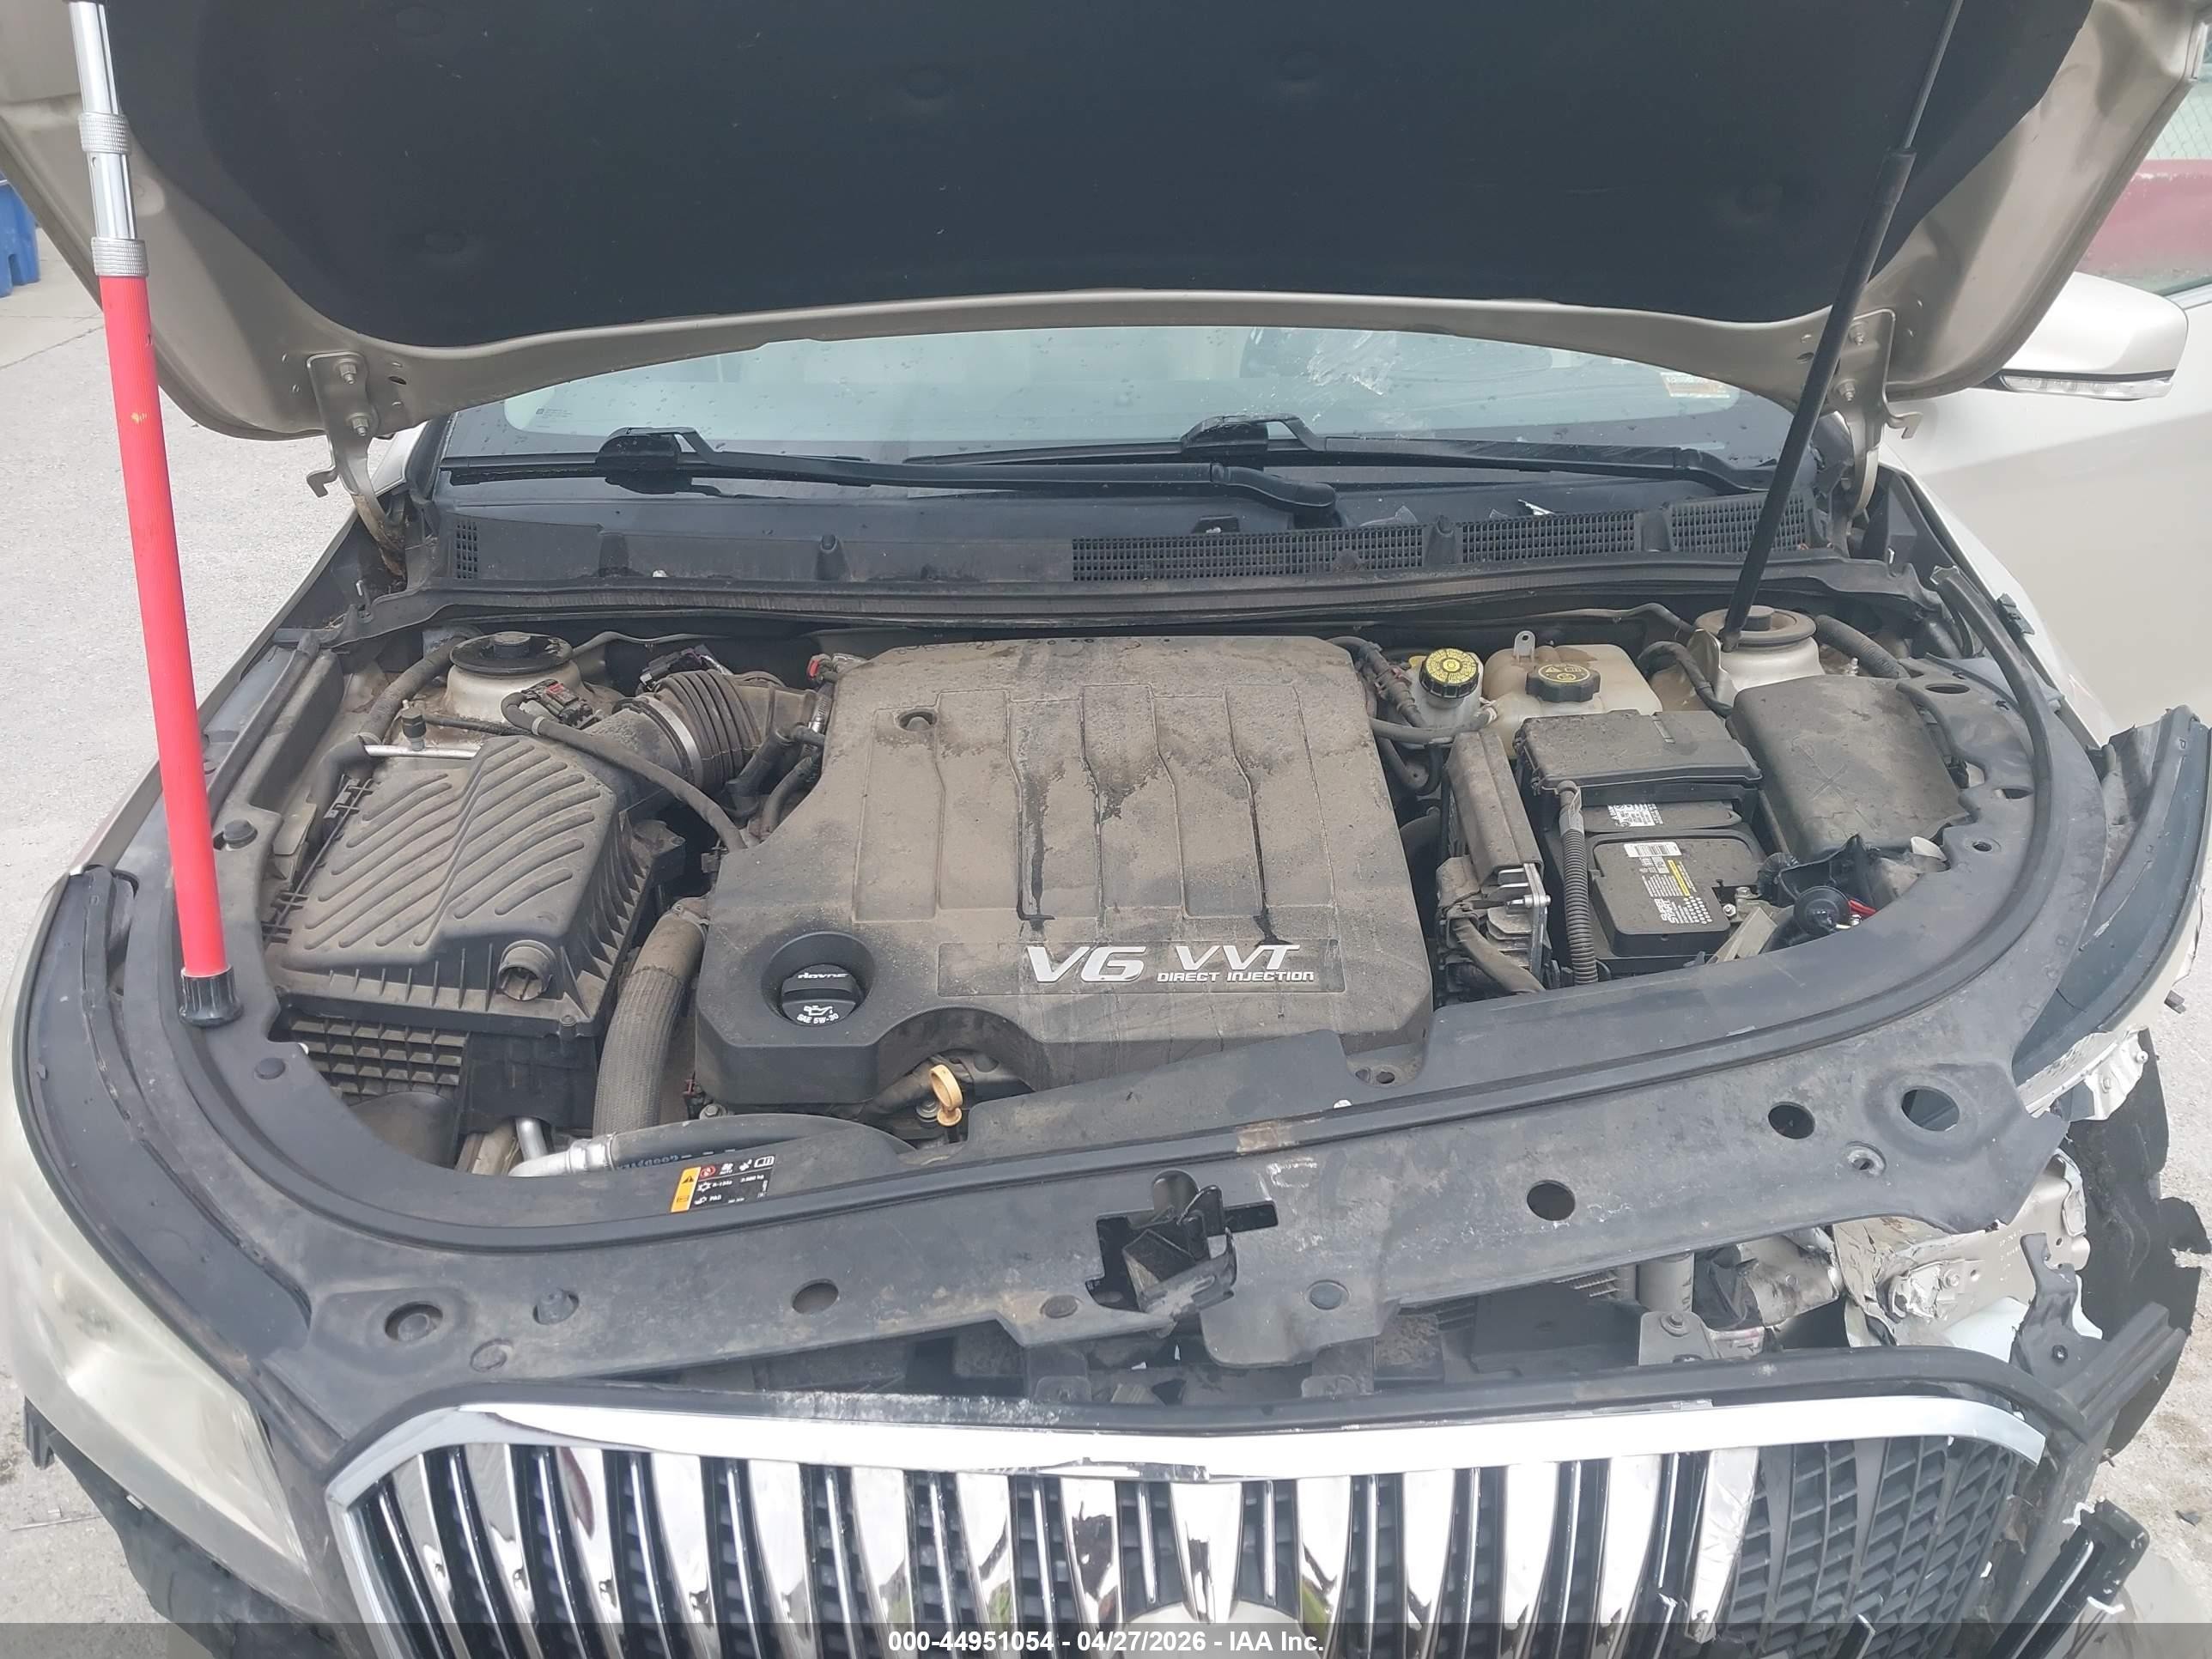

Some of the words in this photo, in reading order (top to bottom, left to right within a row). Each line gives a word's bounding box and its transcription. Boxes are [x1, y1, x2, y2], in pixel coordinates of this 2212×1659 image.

[1026, 945, 1147, 982] V6
[1176, 945, 1301, 971] VVT
[1158, 972, 1220, 982] DIRECT
[1226, 971, 1315, 982] INJECTION
[796, 1013, 812, 1024] SAE
[812, 1012, 839, 1024] 5W-30
